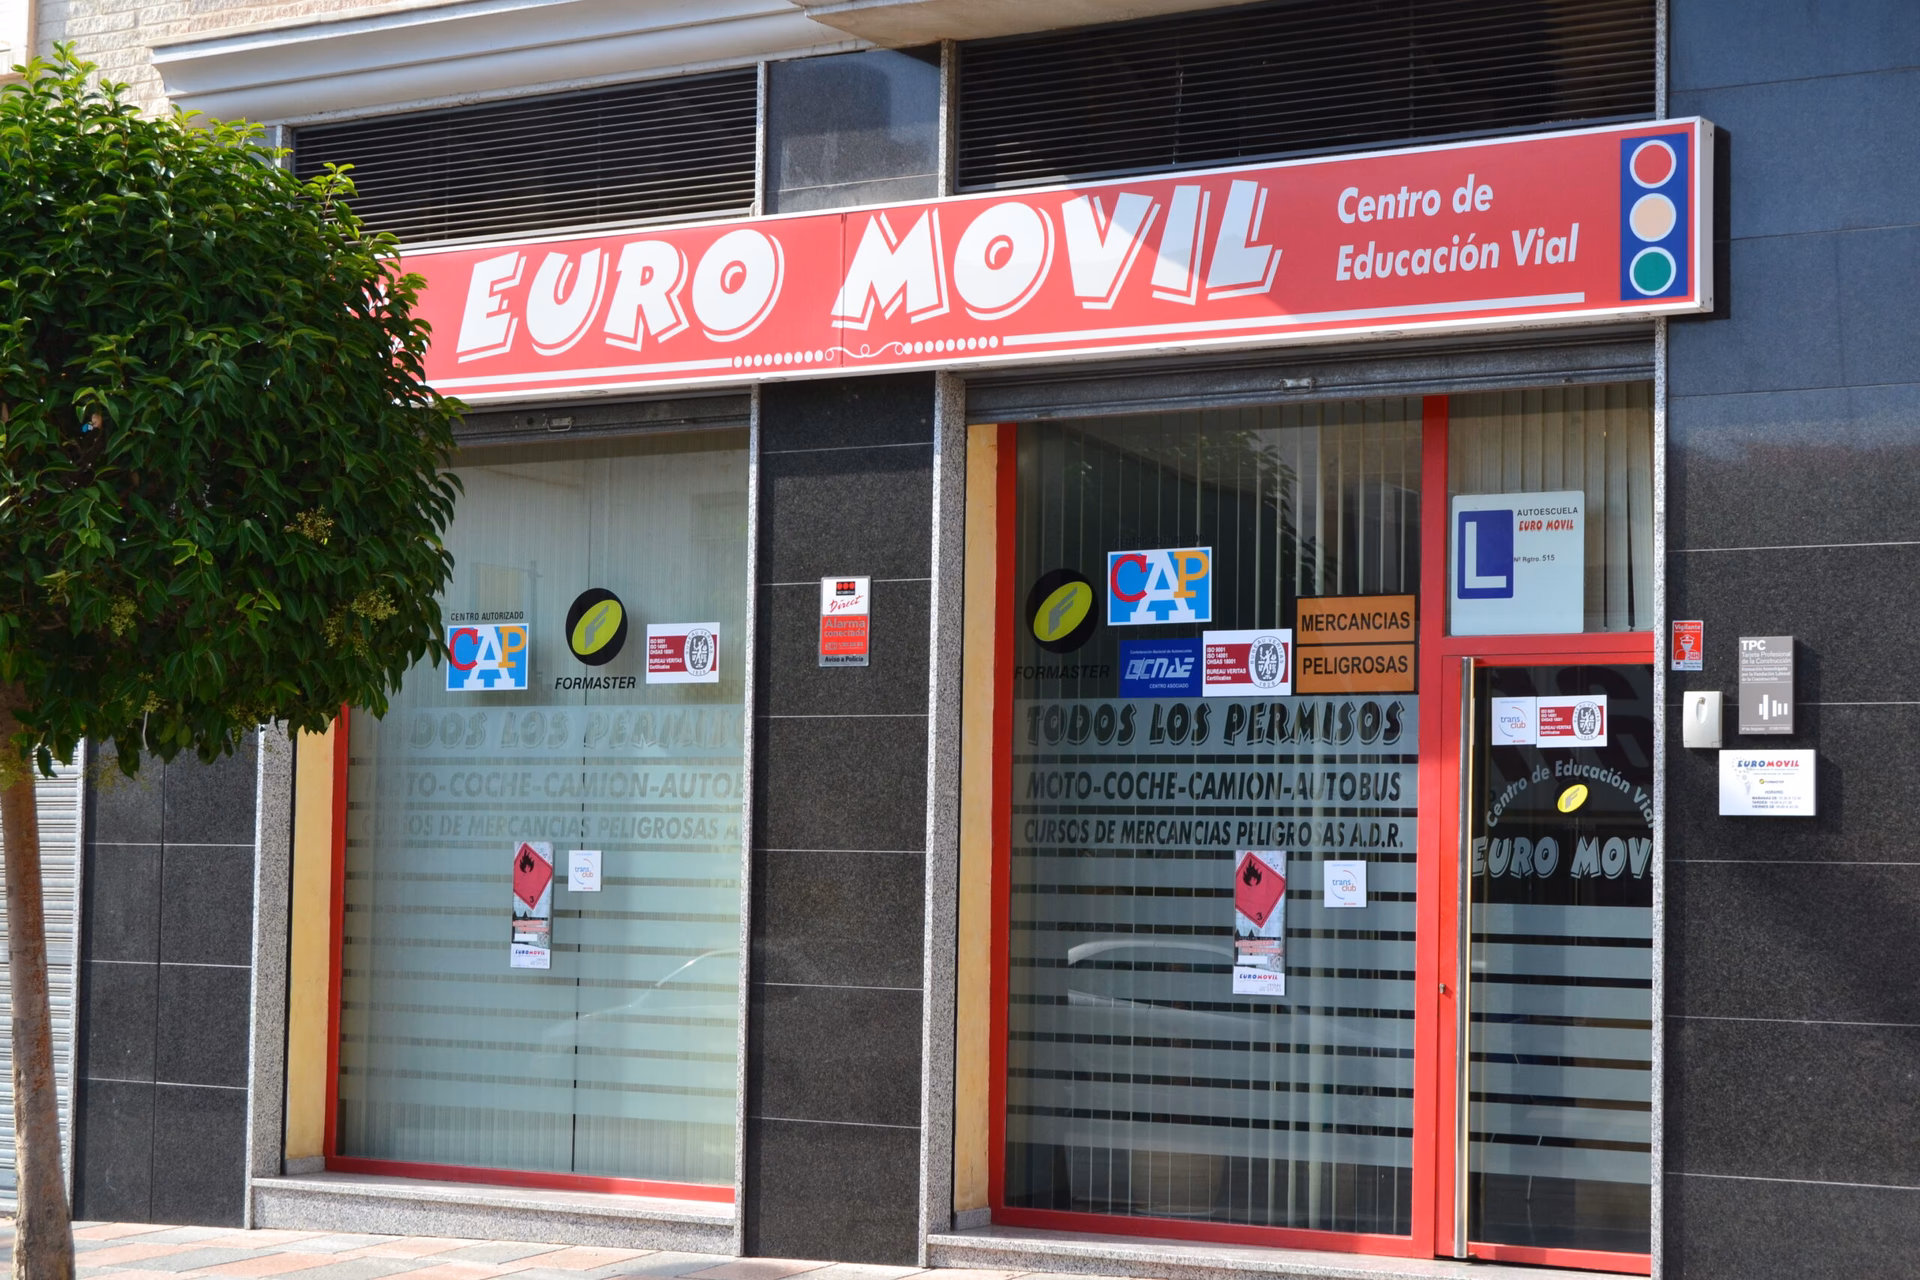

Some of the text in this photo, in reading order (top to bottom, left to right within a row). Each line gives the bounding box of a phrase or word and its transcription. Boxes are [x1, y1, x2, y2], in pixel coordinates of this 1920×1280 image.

[1337, 173, 1493, 224] Centro de
[1336, 222, 1579, 281] Educación Vial
[456, 179, 1283, 363] EURO MOVIL
[1517, 506, 1578, 517] AUTOESCUELA
[1518, 518, 1574, 532] EURO MOVIL
[1464, 521, 1507, 589] L
[1542, 554, 1555, 562] 515
[1110, 549, 1209, 622] CAP
[450, 611, 524, 621] CENTRO AUTORIZADO
[824, 617, 865, 628] Alarma
[1301, 611, 1410, 632] MERCANCIAS
[824, 628, 865, 637] conectada
[1741, 639, 1766, 651] TPC
[449, 626, 527, 688] CAP
[1302, 655, 1409, 675] PELIGROSAS
[1014, 665, 1110, 680] FORMASTER
[554, 676, 636, 690] FORMASTER
[1027, 700, 1405, 746] TODOS LOS PERMISOS
[1500, 715, 1520, 723] trans
[1510, 721, 1526, 729] club
[501, 710, 569, 749] LOS
[1737, 760, 1799, 768] EUROMOVIL
[1026, 771, 1402, 801] MOTO-COCHE-CAMION-AUTOBUS
[1486, 758, 1654, 829] Centro de Educación Via
[440, 815, 463, 836] DE
[467, 815, 591, 838] MERCANCIAS
[597, 816, 718, 840] PELIGROSAS
[1024, 819, 1404, 848] CURSOS DE MERCANCIAS PELIGROSAS A.D.R.
[1472, 835, 1654, 880] EURO MOV
[1341, 883, 1357, 892] club
[1256, 912, 1263, 921] 3
